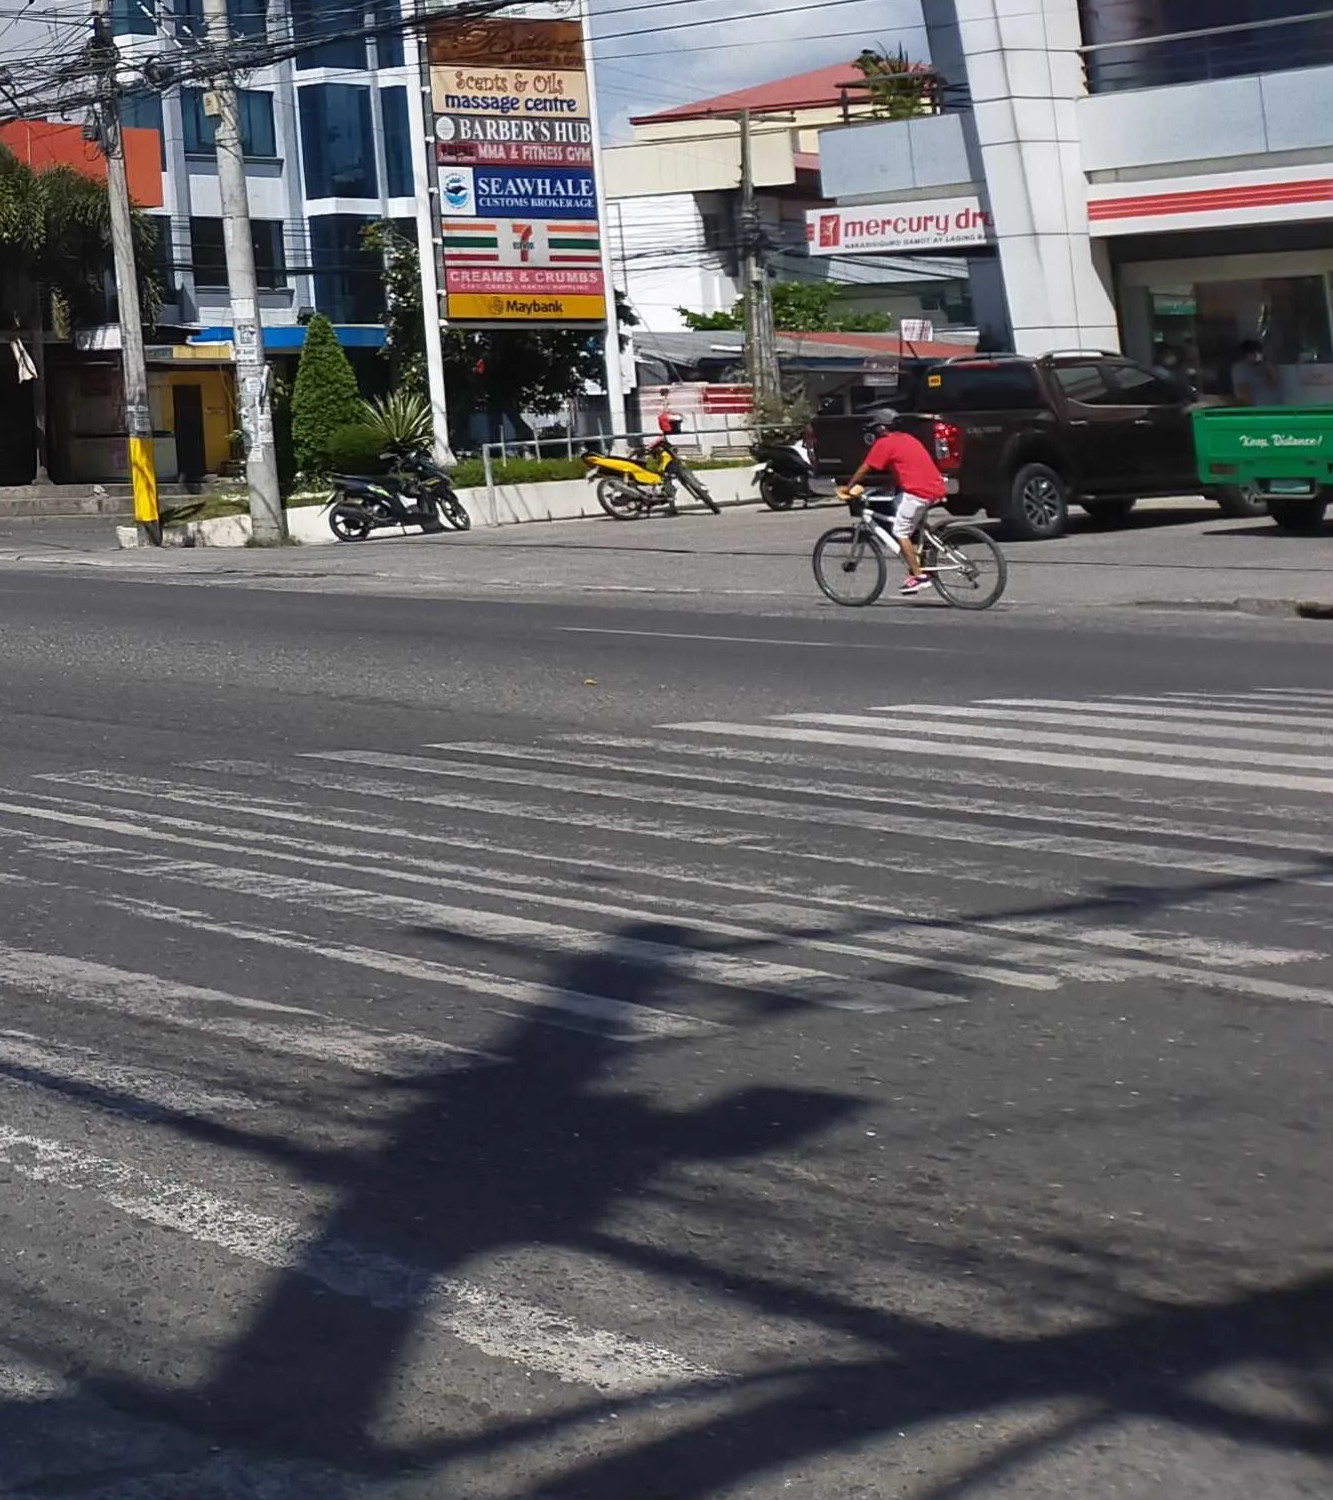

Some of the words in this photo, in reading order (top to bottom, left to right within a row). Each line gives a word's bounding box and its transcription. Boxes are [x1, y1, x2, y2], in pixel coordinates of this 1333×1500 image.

[455, 70, 508, 92] Scents
[514, 73, 529, 92] &
[533, 73, 564, 95] Oils
[445, 94, 519, 113] massage
[524, 97, 577, 112] centre
[460, 118, 551, 142] BARBER'S
[555, 122, 591, 143] HUB
[477, 144, 506, 159] MMA
[509, 146, 519, 159] &
[523, 145, 564, 161] FITNESS
[566, 147, 592, 162] GYM
[478, 177, 594, 197] SEAWHALE
[479, 197, 529, 207] CUSTOMS
[531, 198, 595, 208] BROKERAGE
[844, 213, 949, 237] mercury
[449, 271, 514, 283] CREAMS
[519, 271, 530, 283] &
[535, 272, 598, 284] CRUMBS
[506, 300, 563, 315] Maybank
[1239, 434, 1269, 448] Keep
[1271, 433, 1323, 447] Distance!
